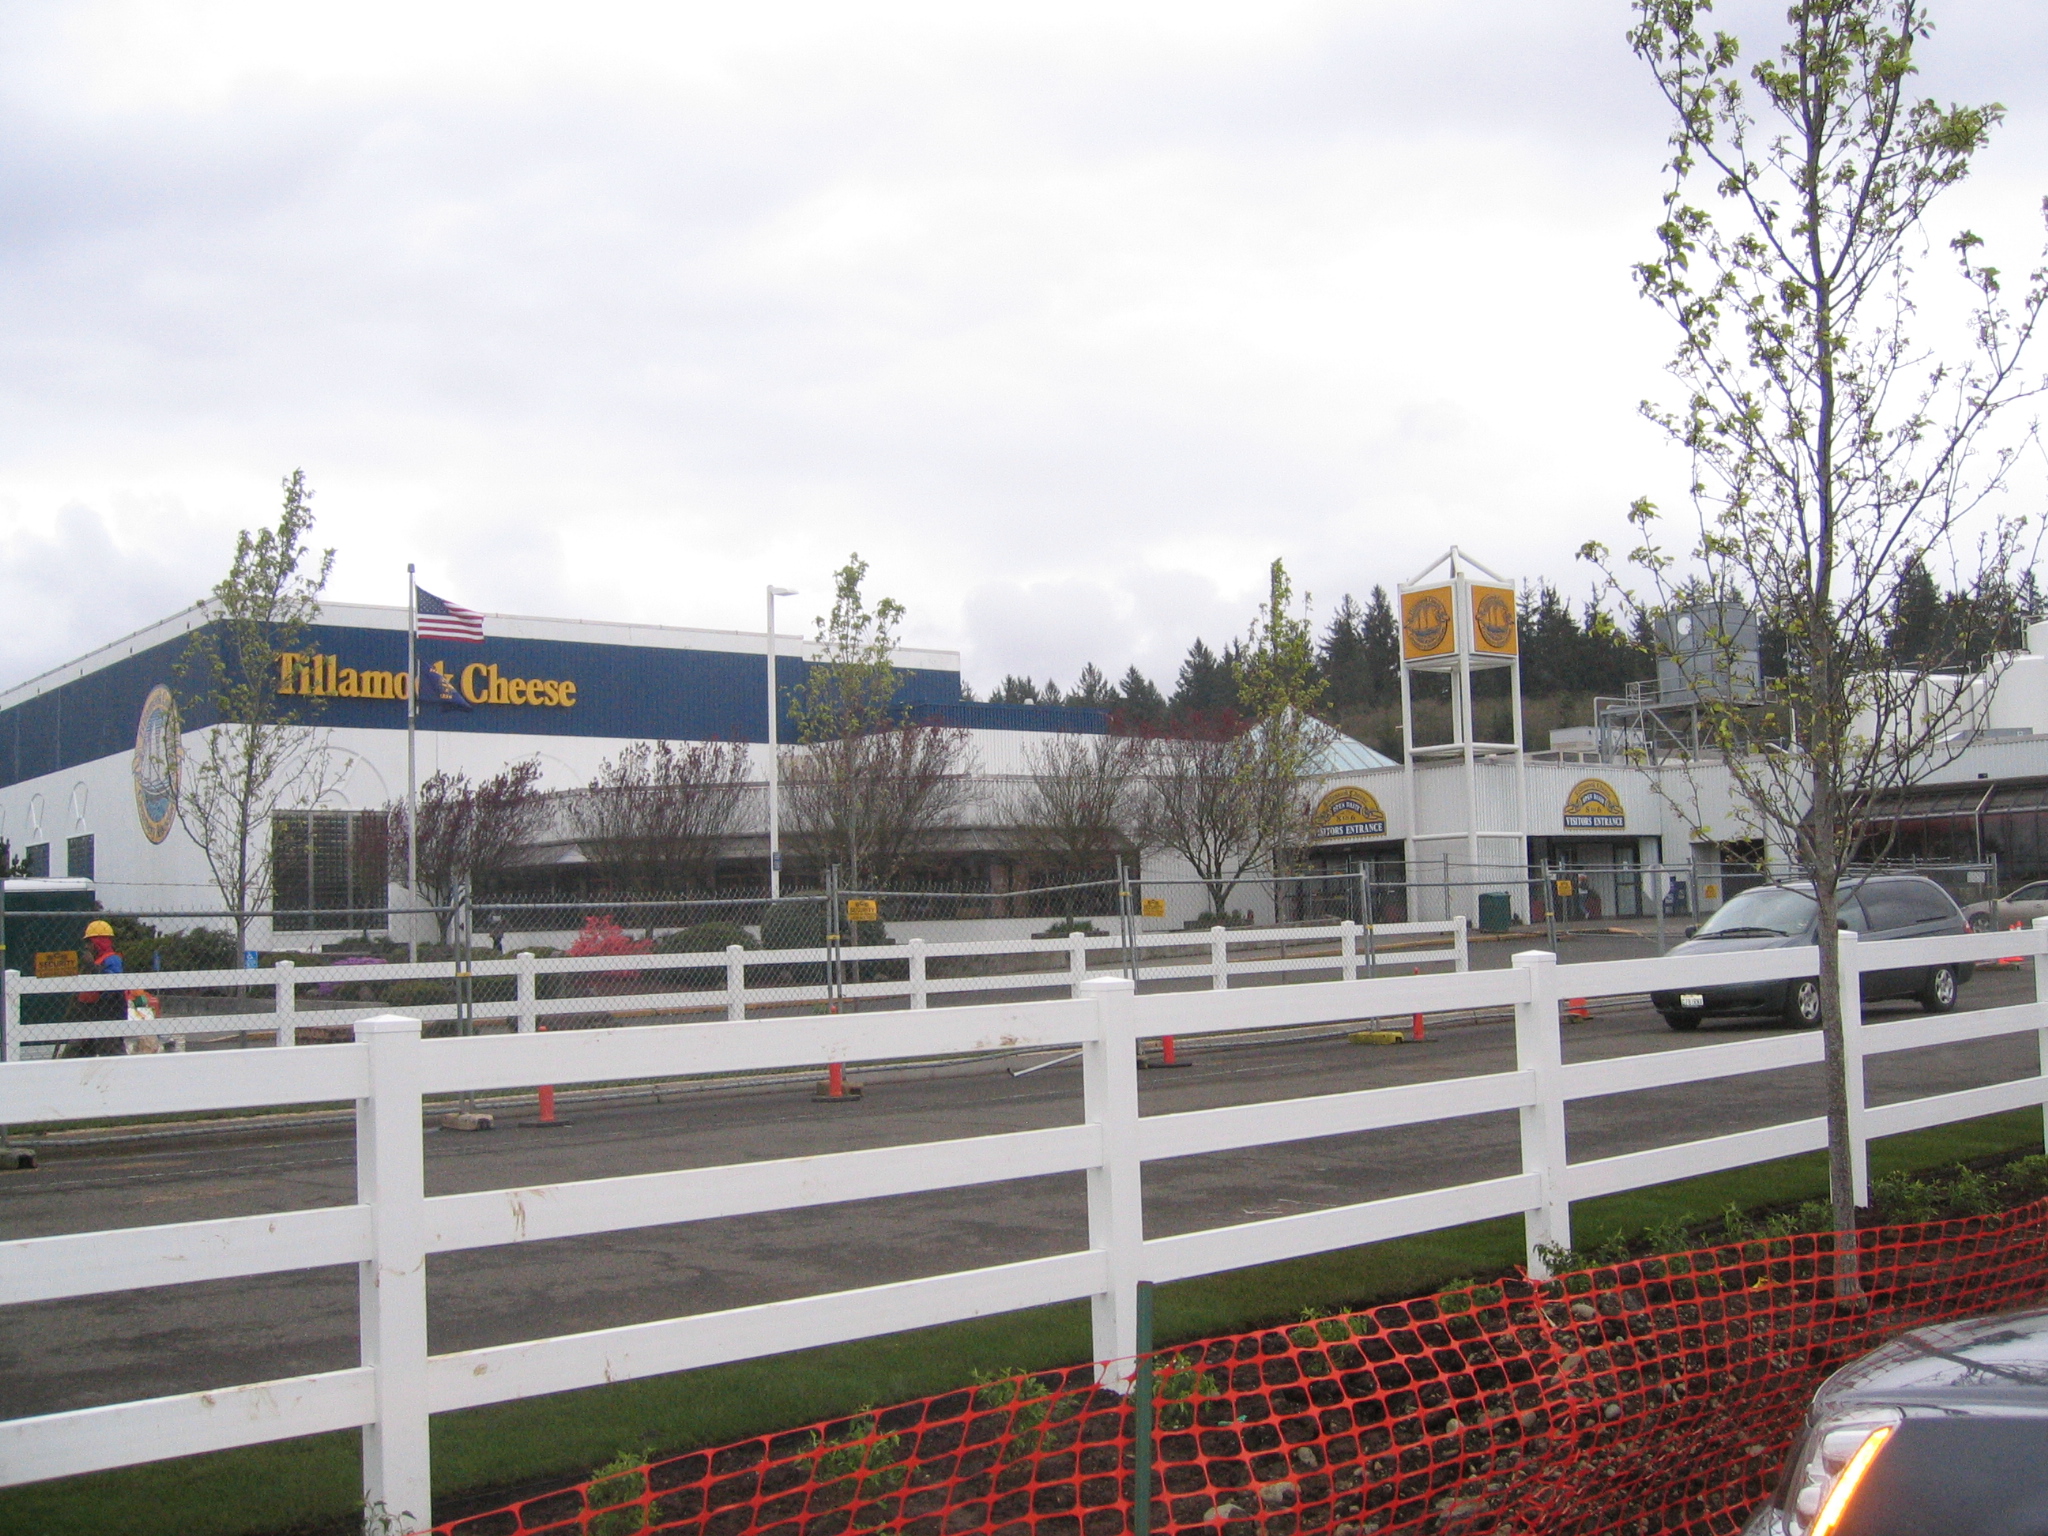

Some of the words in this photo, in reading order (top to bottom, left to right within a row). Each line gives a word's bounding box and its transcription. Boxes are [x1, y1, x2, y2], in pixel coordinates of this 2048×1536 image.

[274, 651, 454, 701] Tillamo
[460, 662, 577, 707] Cheese
[1332, 801, 1346, 813] OPEN
[1565, 816, 1592, 826] VISITORS
[1593, 816, 1624, 826] ENTRANCE
[1317, 826, 1344, 837] SITORS
[1346, 823, 1383, 834] ENTRANCE
[38, 959, 76, 969] SECURITY
